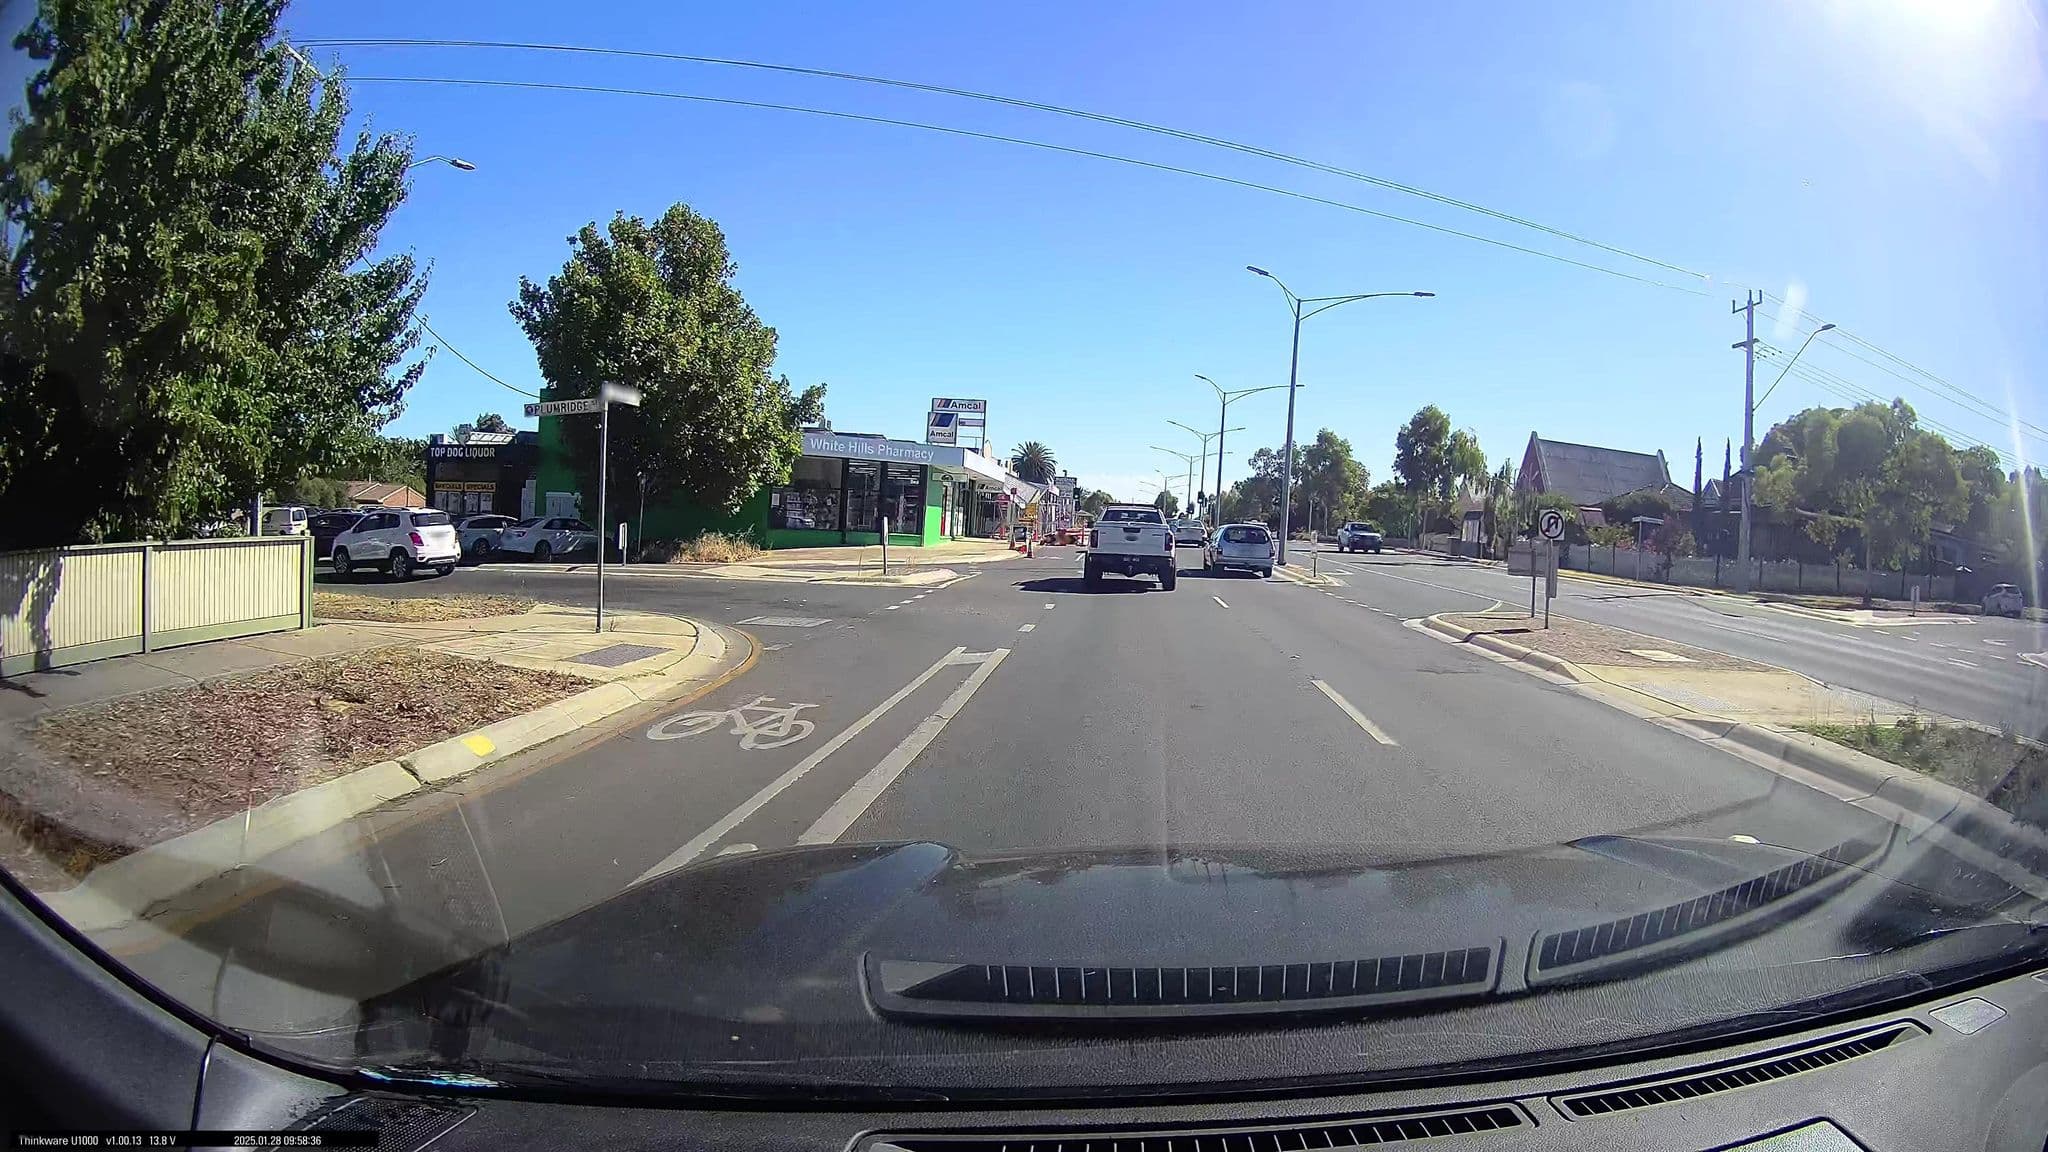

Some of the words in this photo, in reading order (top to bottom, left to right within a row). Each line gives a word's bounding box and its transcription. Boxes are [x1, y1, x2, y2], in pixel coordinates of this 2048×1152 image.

[534, 401, 588, 416] PLUMRIDGE
[950, 401, 981, 410] Amcal
[930, 430, 954, 438] Amcal
[430, 447, 446, 457] TOP
[447, 447, 464, 457] DOG
[465, 447, 495, 459] LIQUOR
[810, 438, 845, 452] White
[848, 441, 874, 455] Hills
[877, 444, 934, 461] Pharmacy
